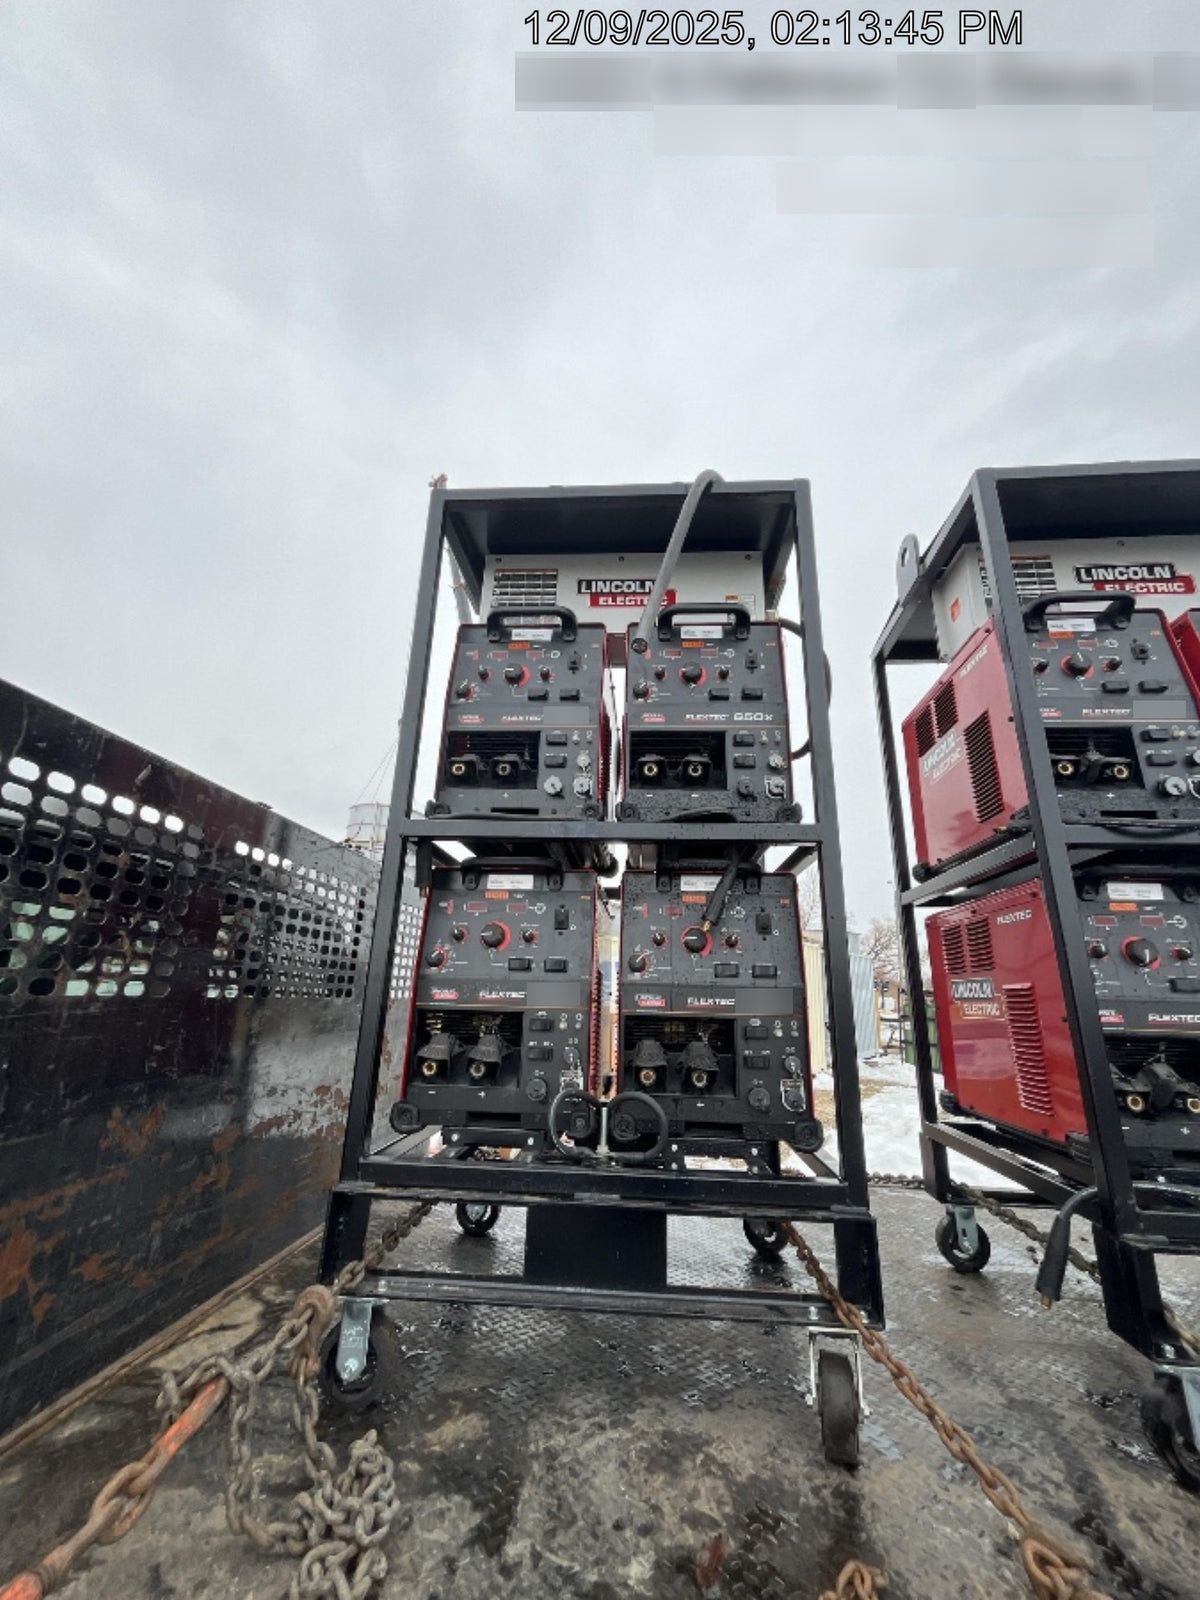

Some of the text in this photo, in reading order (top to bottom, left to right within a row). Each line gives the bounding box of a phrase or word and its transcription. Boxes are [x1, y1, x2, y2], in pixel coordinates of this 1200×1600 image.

[1080, 565, 1171, 581] LINCOLN
[579, 579, 656, 594] LINCOLN
[685, 713, 727, 721] FLEXTEC
[479, 990, 526, 999] FLEXTEC
[952, 982, 995, 999] LINCOLN
[687, 997, 736, 1006] FLEXTEC
[963, 1001, 1001, 1016] ELECTRIC
